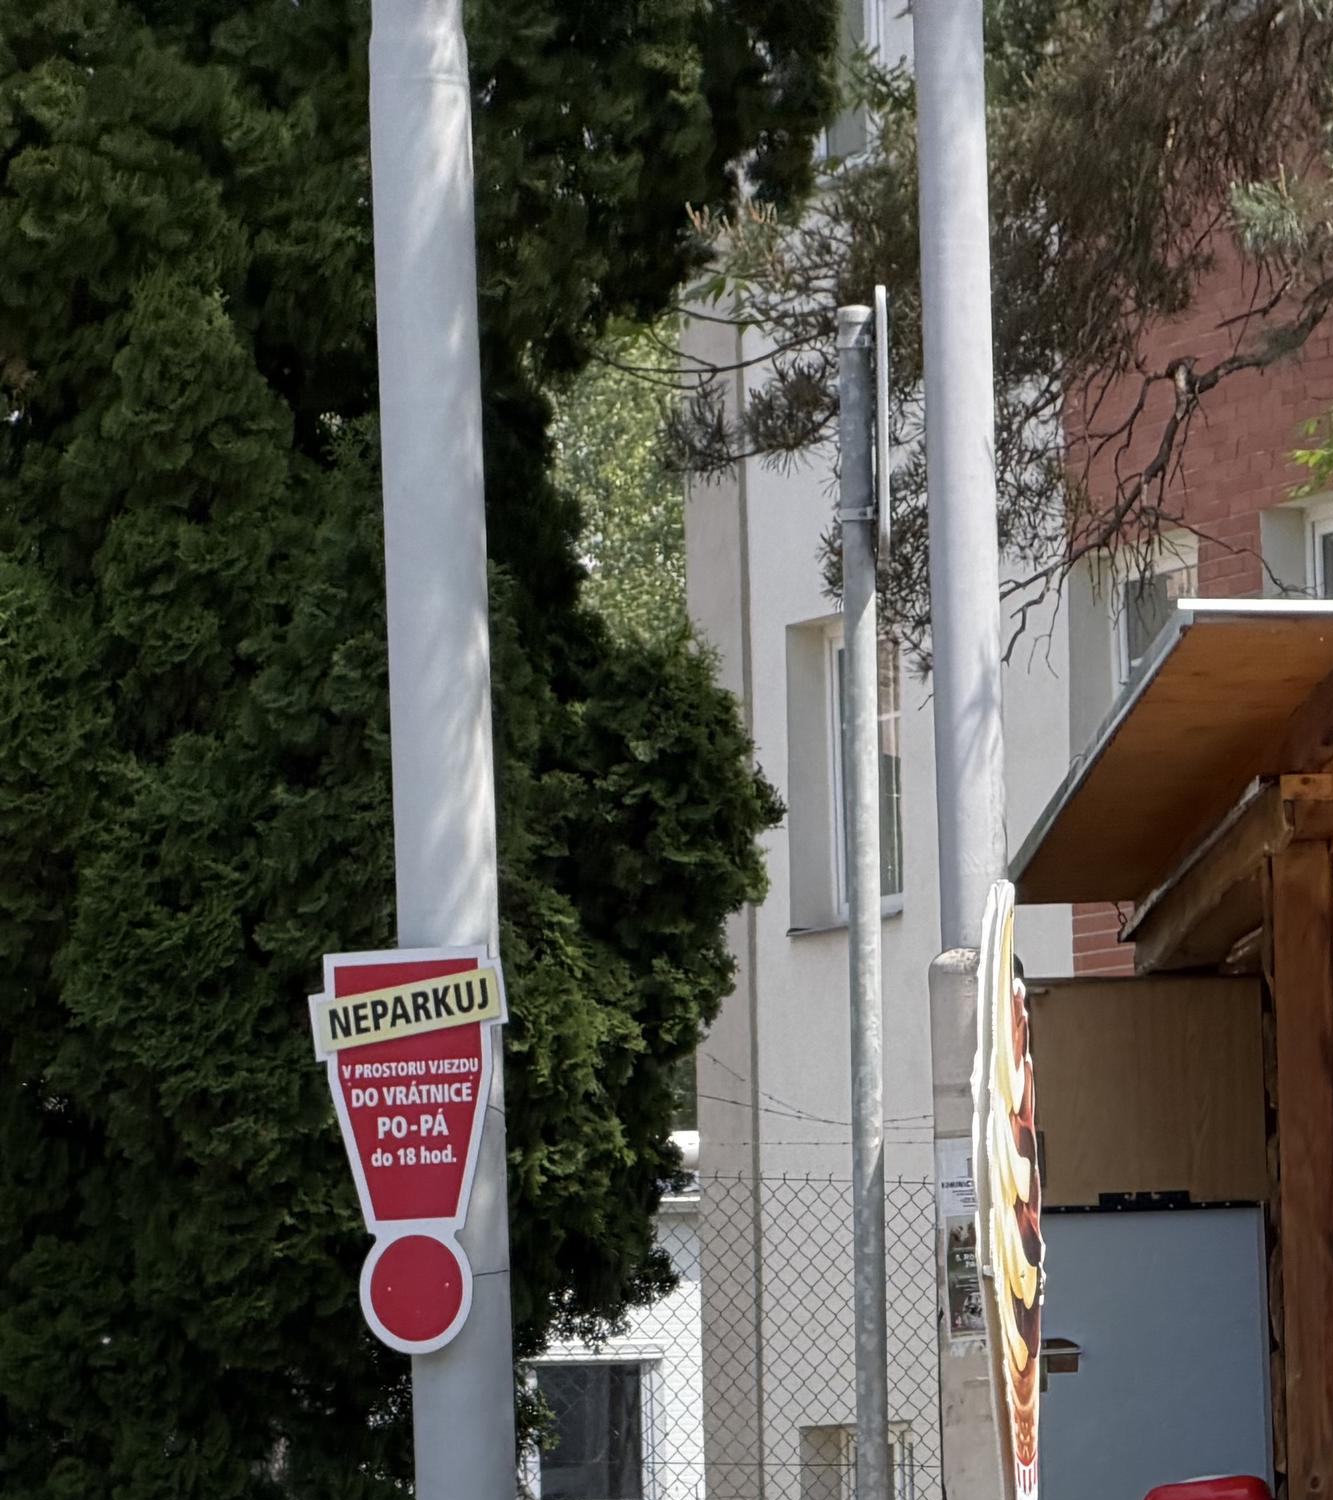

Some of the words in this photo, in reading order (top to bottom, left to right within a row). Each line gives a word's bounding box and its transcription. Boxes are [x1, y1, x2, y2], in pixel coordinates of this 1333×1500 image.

[329, 977, 489, 1041] NEPARKUJ
[342, 1065, 351, 1079] V
[355, 1061, 426, 1079] PROSTORU
[428, 1057, 479, 1075] VJEZDU
[351, 1088, 379, 1108] DO
[382, 1080, 473, 1106] VRÁTNICE
[371, 1148, 393, 1168] do
[397, 1147, 416, 1166] 18
[420, 1144, 457, 1165] hod.
